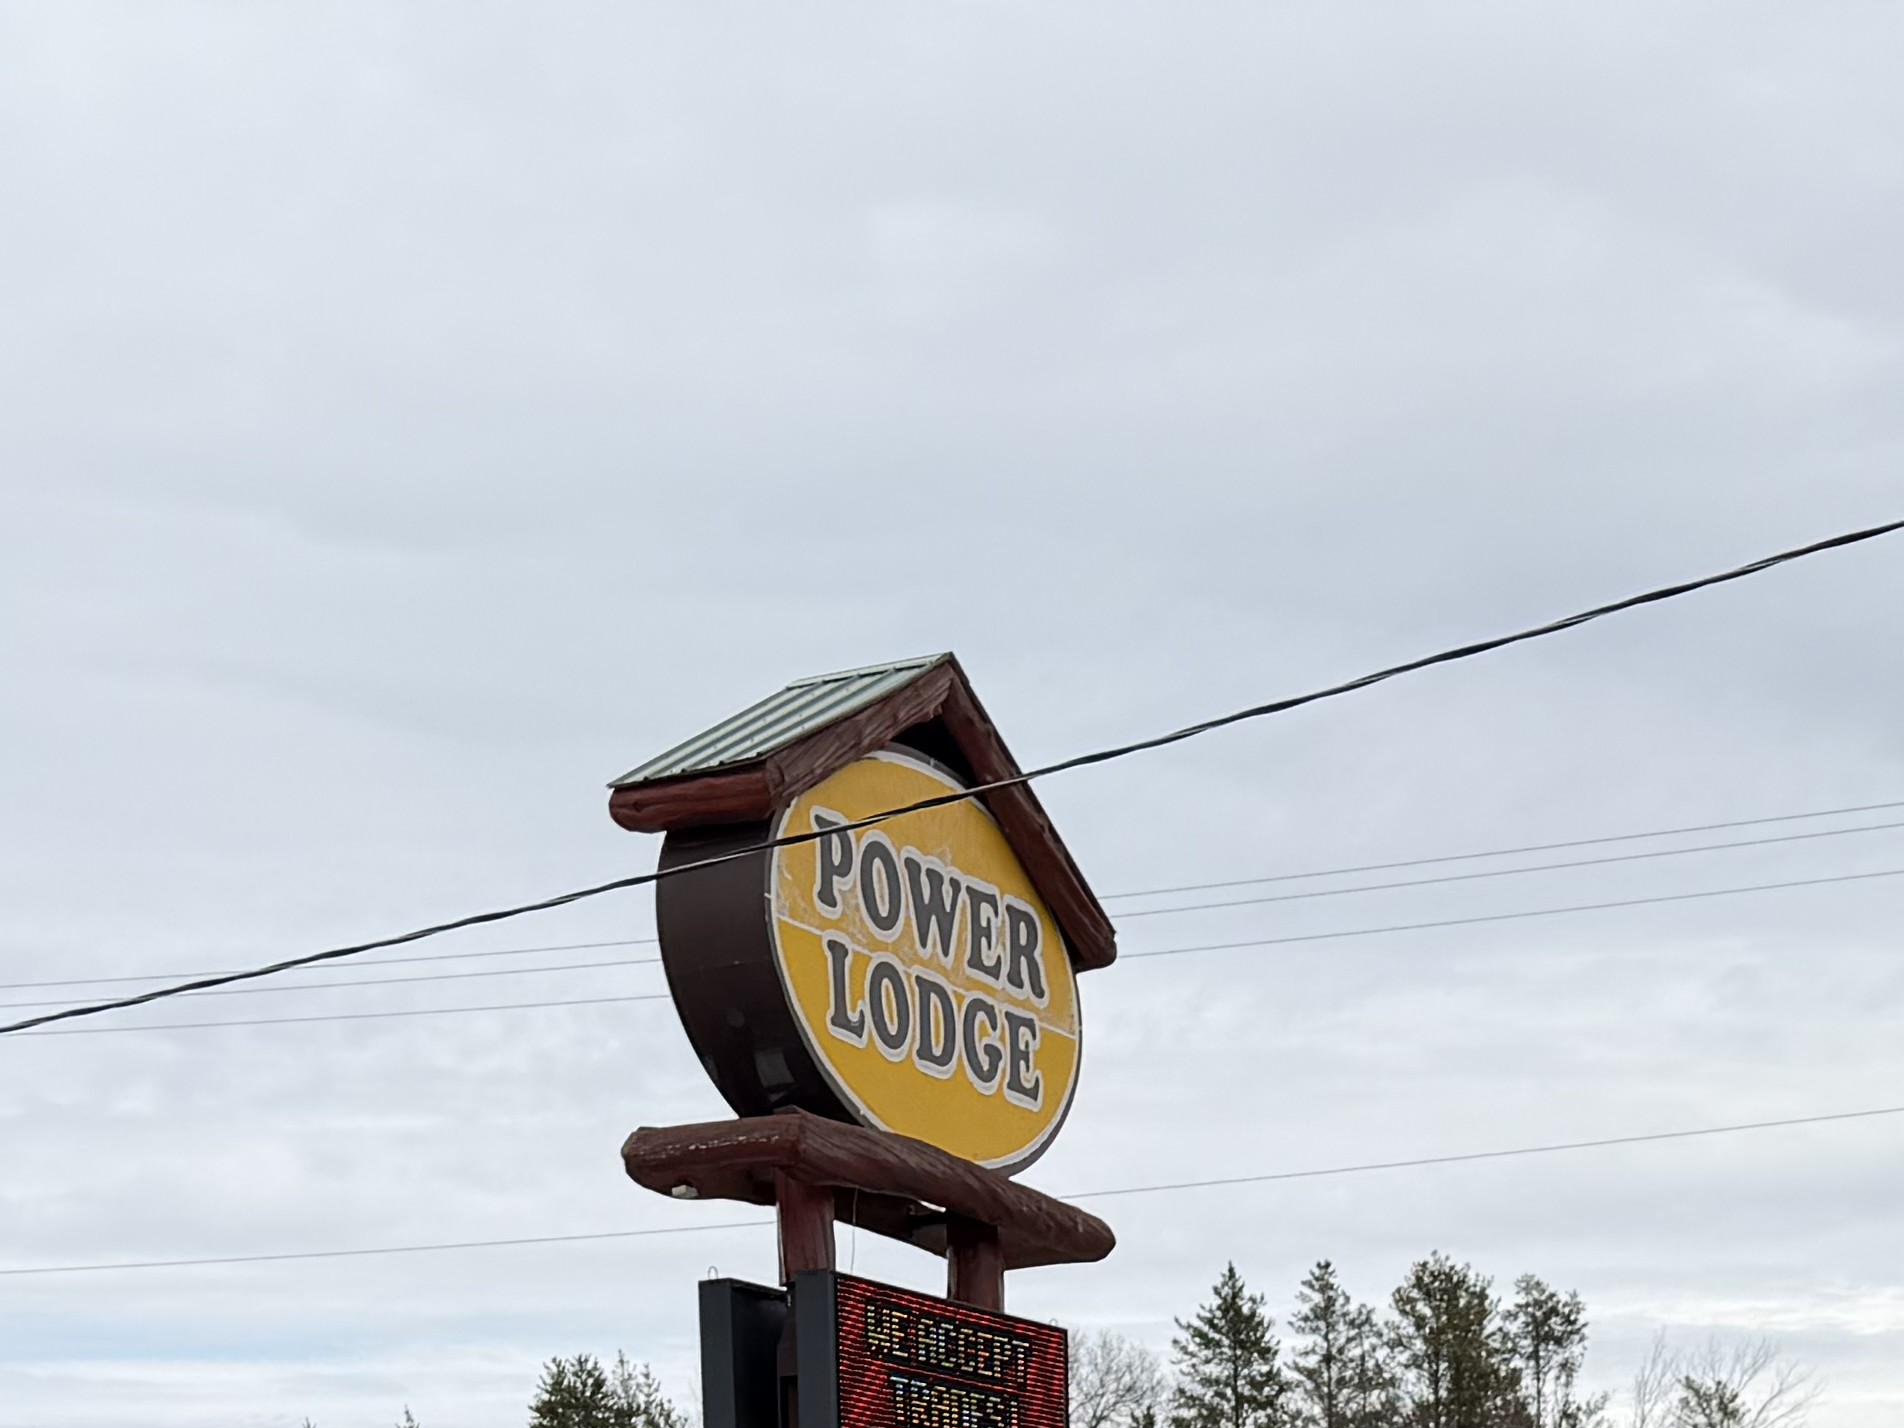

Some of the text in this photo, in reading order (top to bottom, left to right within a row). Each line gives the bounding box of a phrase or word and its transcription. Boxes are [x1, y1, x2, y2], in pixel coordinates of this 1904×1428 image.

[811, 808, 1047, 1006] POWER
[824, 934, 1042, 1110] LODGE
[866, 1305, 1030, 1384] WE ACCEPT
